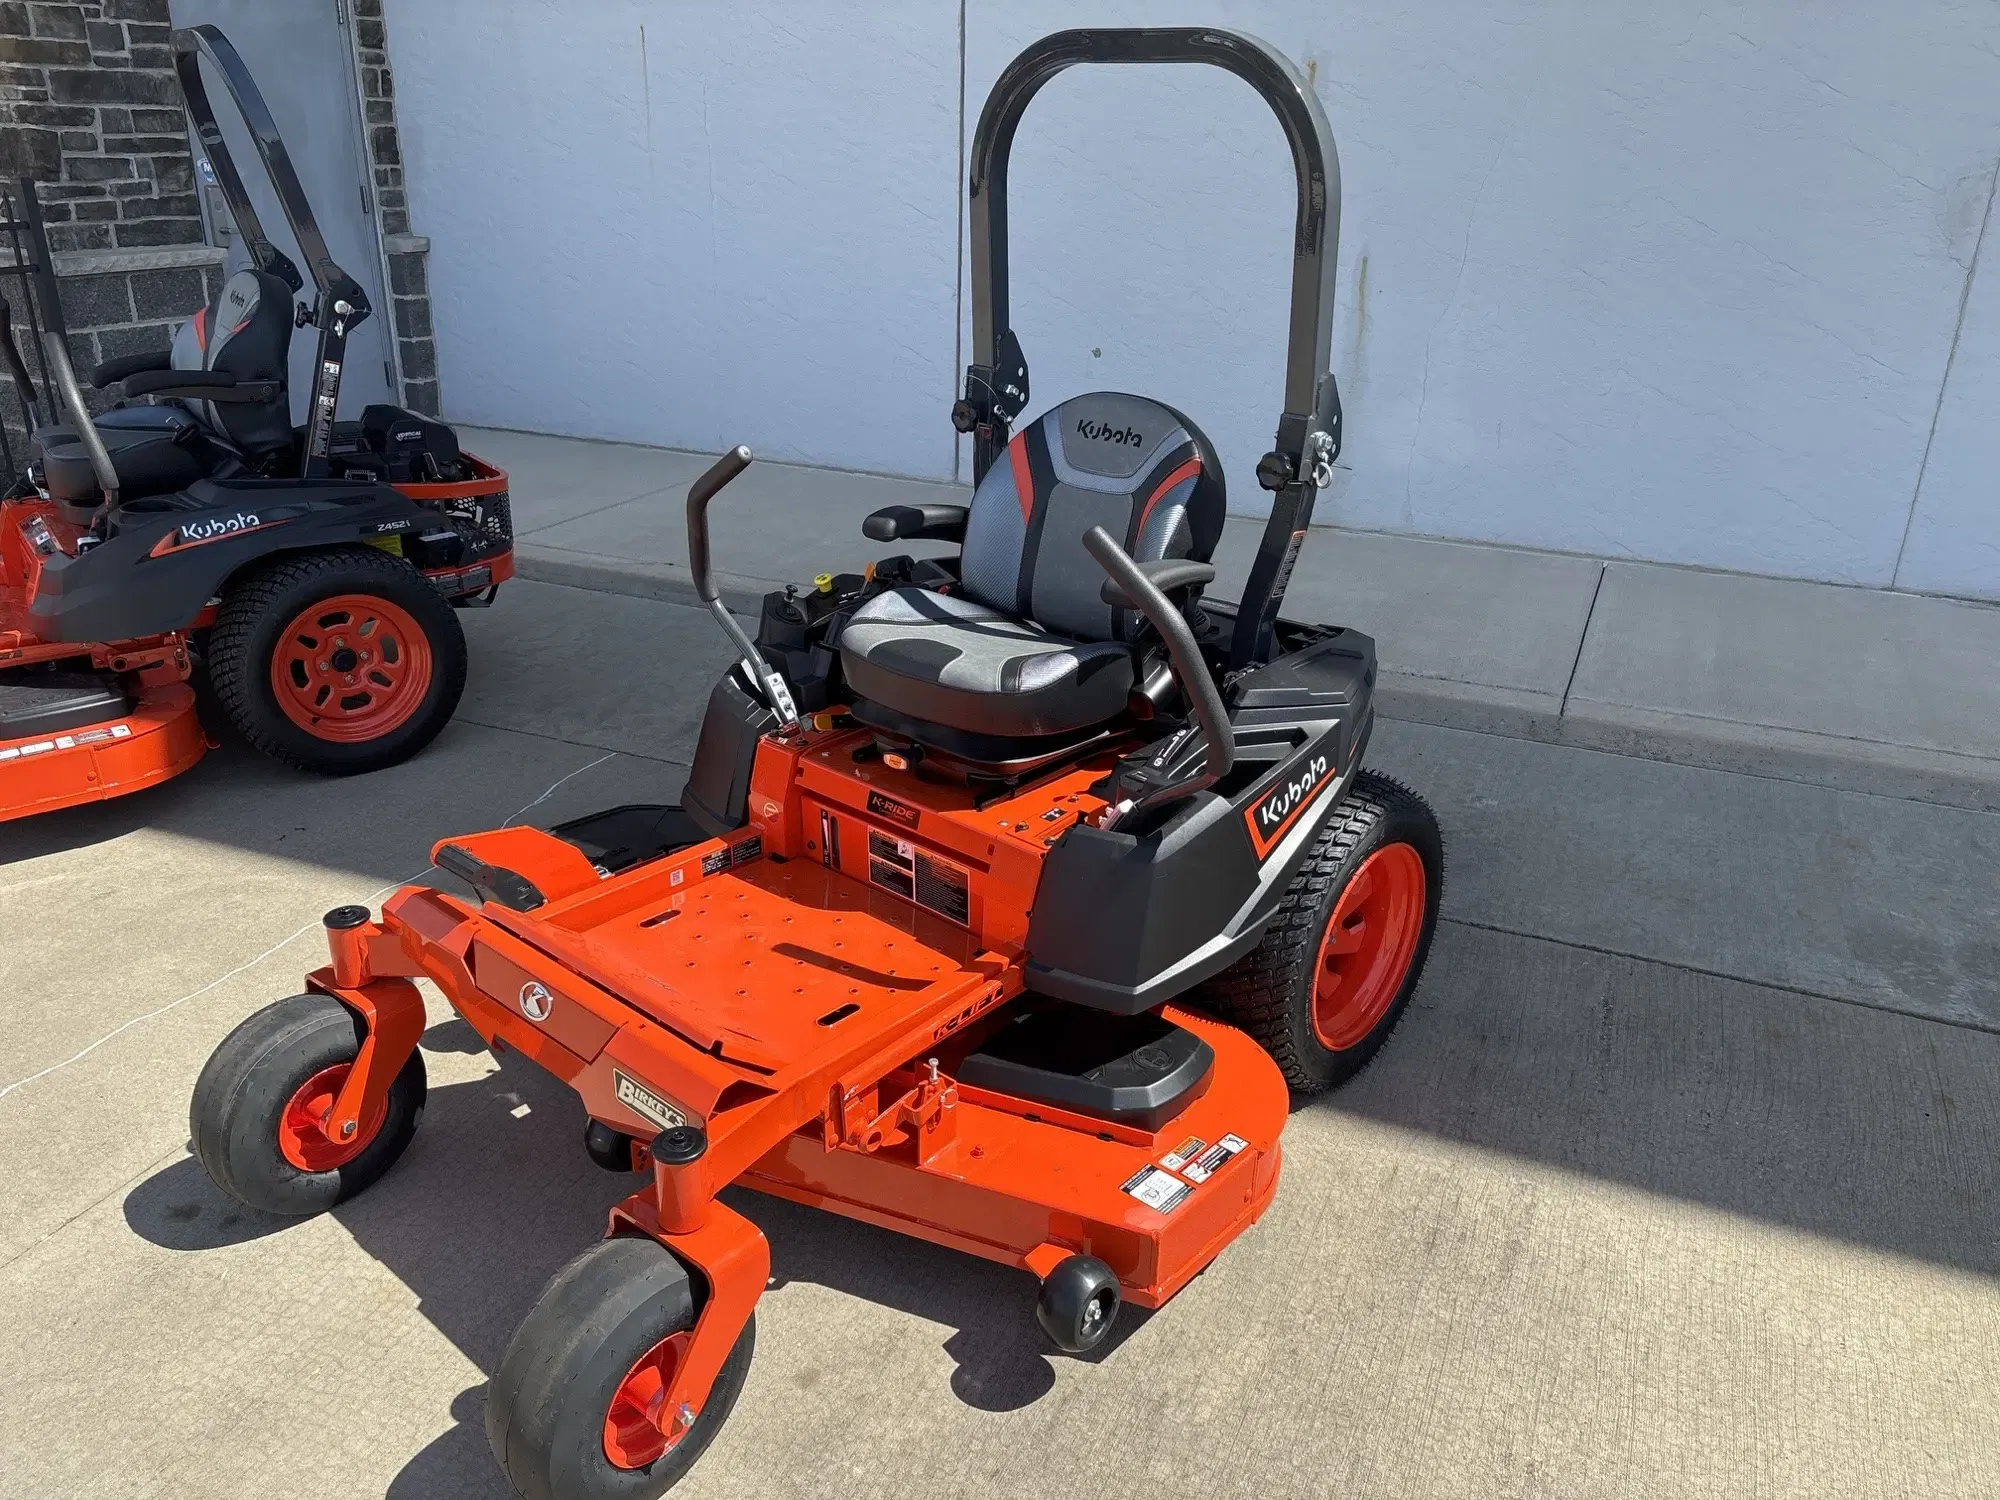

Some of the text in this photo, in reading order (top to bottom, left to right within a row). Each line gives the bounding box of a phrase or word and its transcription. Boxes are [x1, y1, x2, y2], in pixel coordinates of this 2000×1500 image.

[1077, 419, 1143, 448] Kubota
[181, 513, 260, 539] Kubota
[872, 796, 917, 820] K-RIDE
[1262, 756, 1327, 824] Kubota
[934, 985, 1004, 1041] K-LIFT
[617, 1078, 685, 1127] BIRKEY'S
